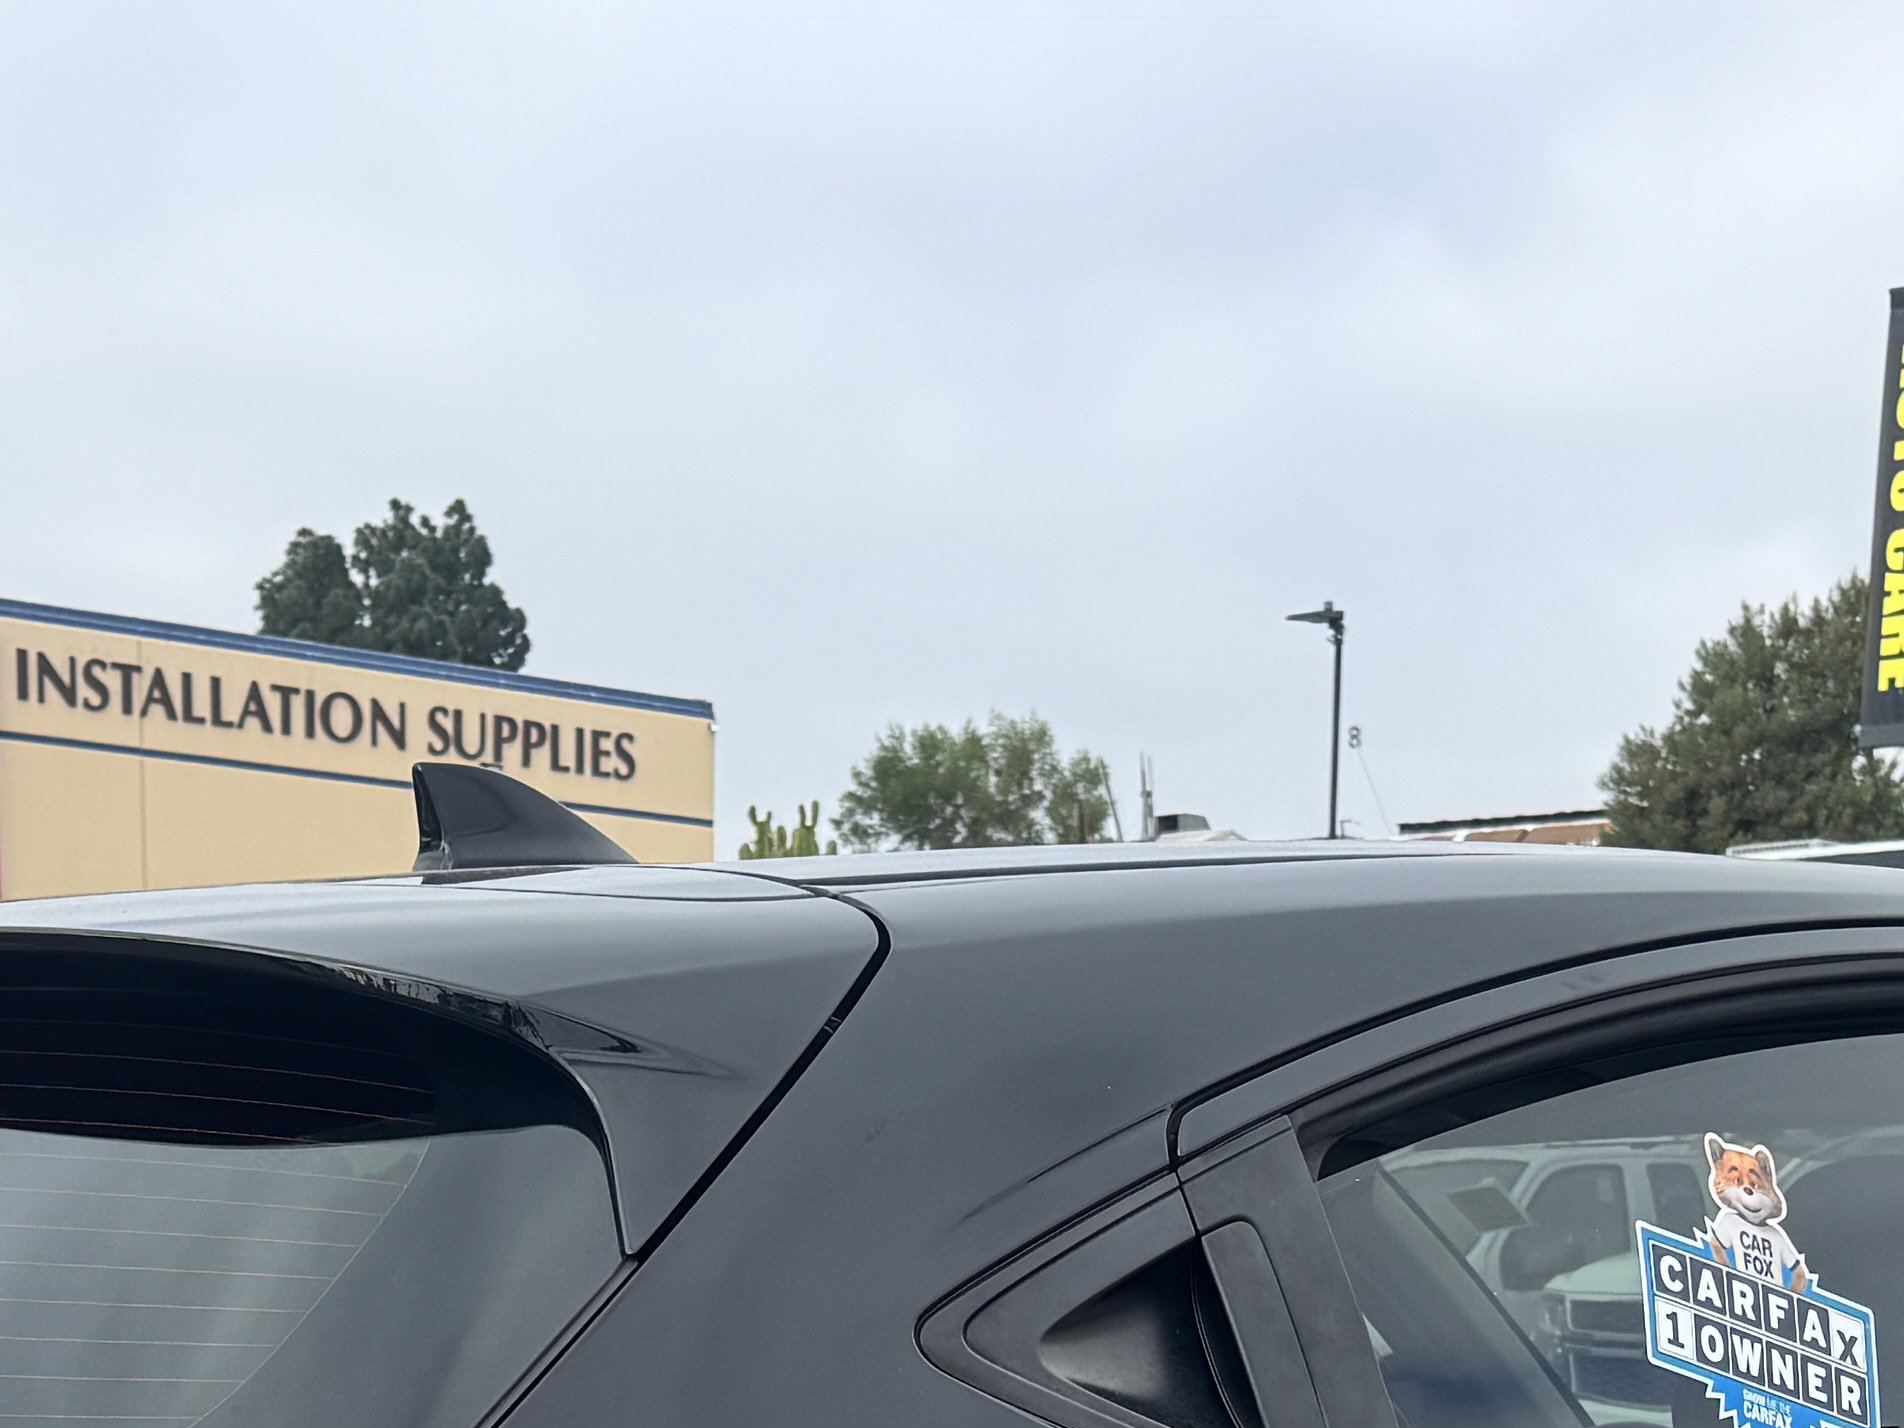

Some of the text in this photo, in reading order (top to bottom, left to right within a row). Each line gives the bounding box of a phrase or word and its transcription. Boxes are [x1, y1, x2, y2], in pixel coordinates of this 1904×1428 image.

[14, 646, 638, 781] INSTALLATION SUPPLIES
[1739, 1230, 1774, 1258] CAR
[1745, 1252, 1775, 1280] FOX
[1659, 1254, 1858, 1370] CARFAX
[1665, 1311, 1863, 1416] 1 OWNER
